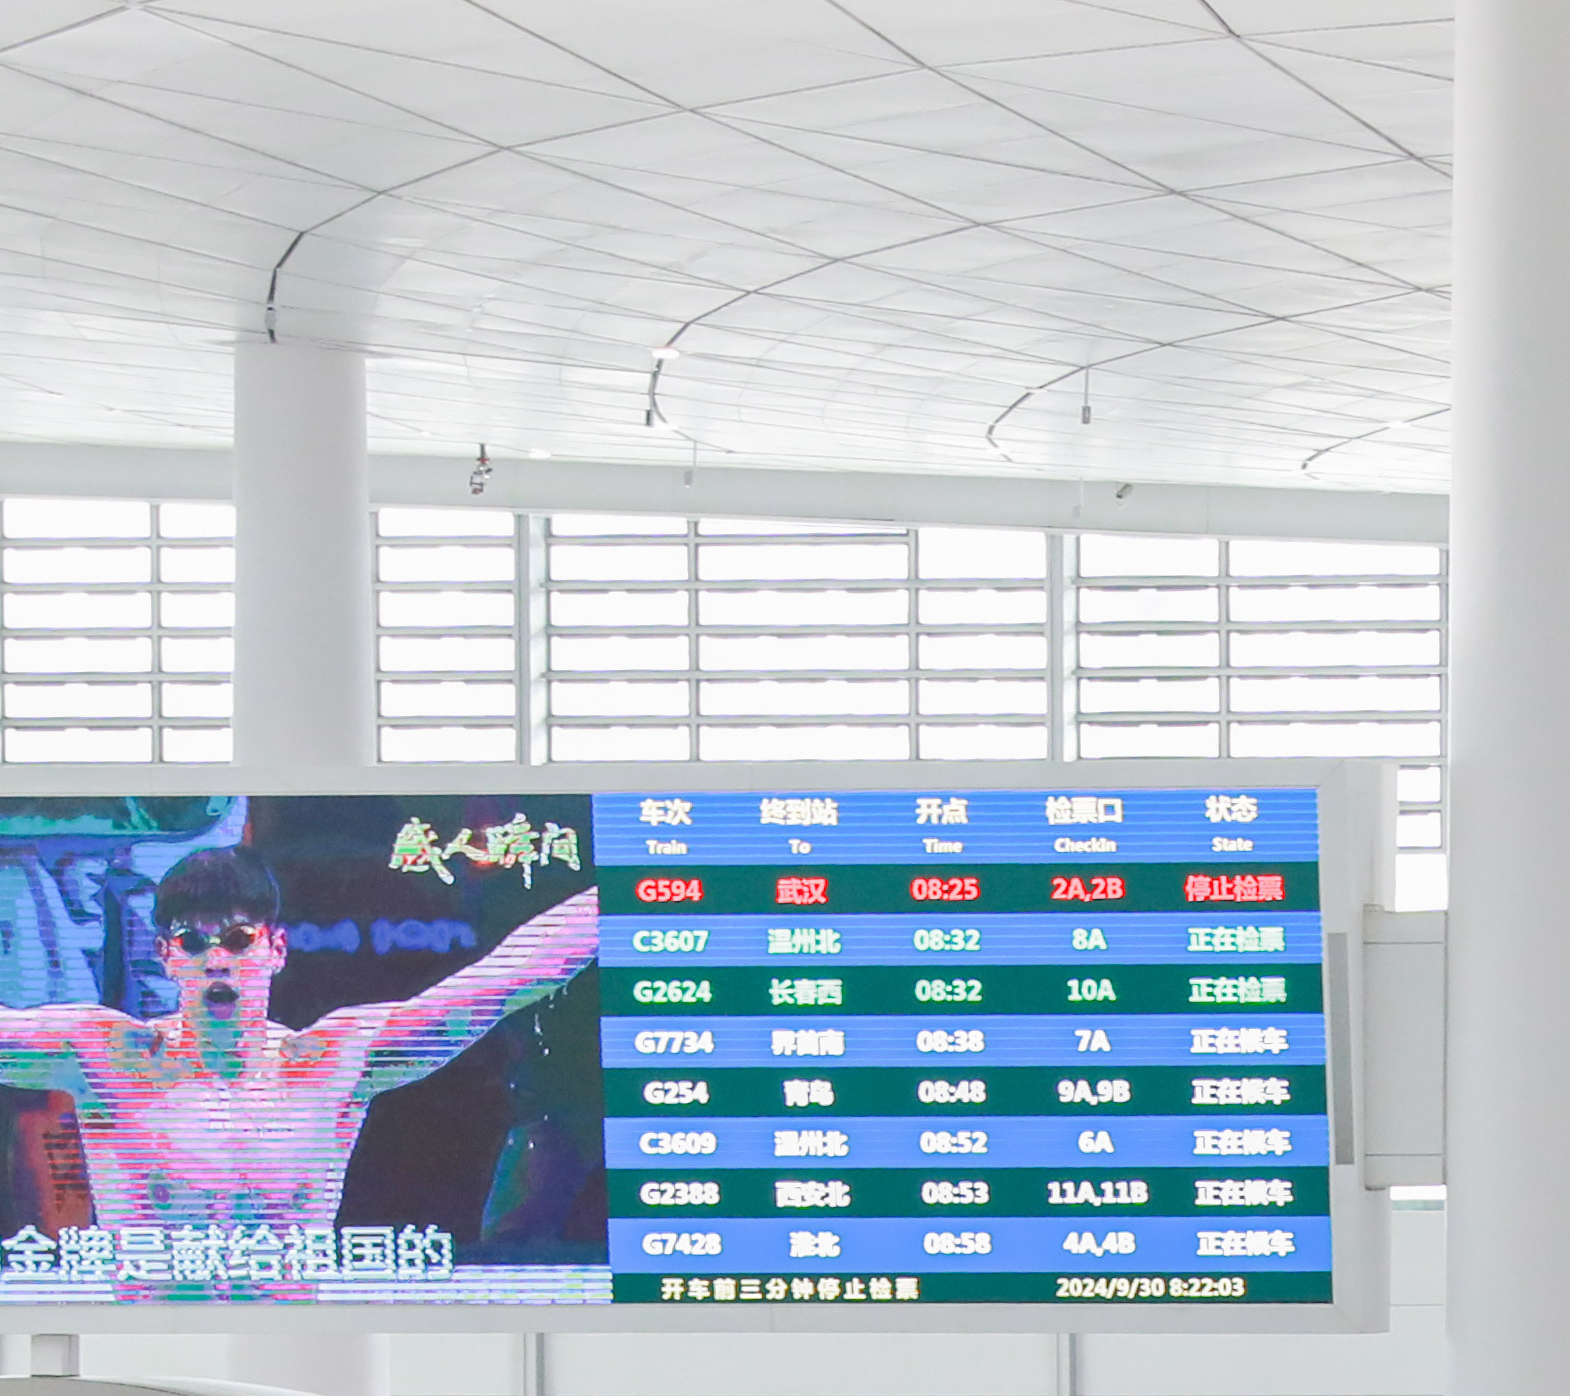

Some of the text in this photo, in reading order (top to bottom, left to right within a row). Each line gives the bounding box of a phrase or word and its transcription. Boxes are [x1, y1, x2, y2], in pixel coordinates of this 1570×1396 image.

[640, 796, 1258, 826] 车次 终到站 开点 检票口 状态
[646, 840, 687, 854] Train
[789, 839, 811, 853] To
[923, 838, 963, 853] Time
[1212, 837, 1253, 851] State
[635, 874, 1285, 904] G594 武汉 08:25 2A,2B 停止检票
[633, 926, 1284, 953] C3607 温州北 08:32 8A 正在检票
[634, 977, 1286, 1004] G2624 长春西 08:32 10A 正在检票
[635, 1031, 714, 1053] G7734
[917, 1030, 984, 1052] 08:38
[1075, 1030, 1111, 1051] 7A
[1190, 1027, 1289, 1053] 正在候车
[644, 1078, 1290, 1106] G254 青岛 08:48 9A,9B 正在候车
[639, 1128, 1292, 1156] C3609 温州北 08:52 6A 正在候车
[640, 1179, 1293, 1207] G2388 西安北 08:53 11A,11B 正在候车
[642, 1230, 1295, 1257] G7428 淮北 08:58 4A,4B 正在候车
[662, 1278, 918, 1300] 开车前三分钟停止检票
[1057, 1278, 1244, 1298] 2024/9/30 8:22:03
